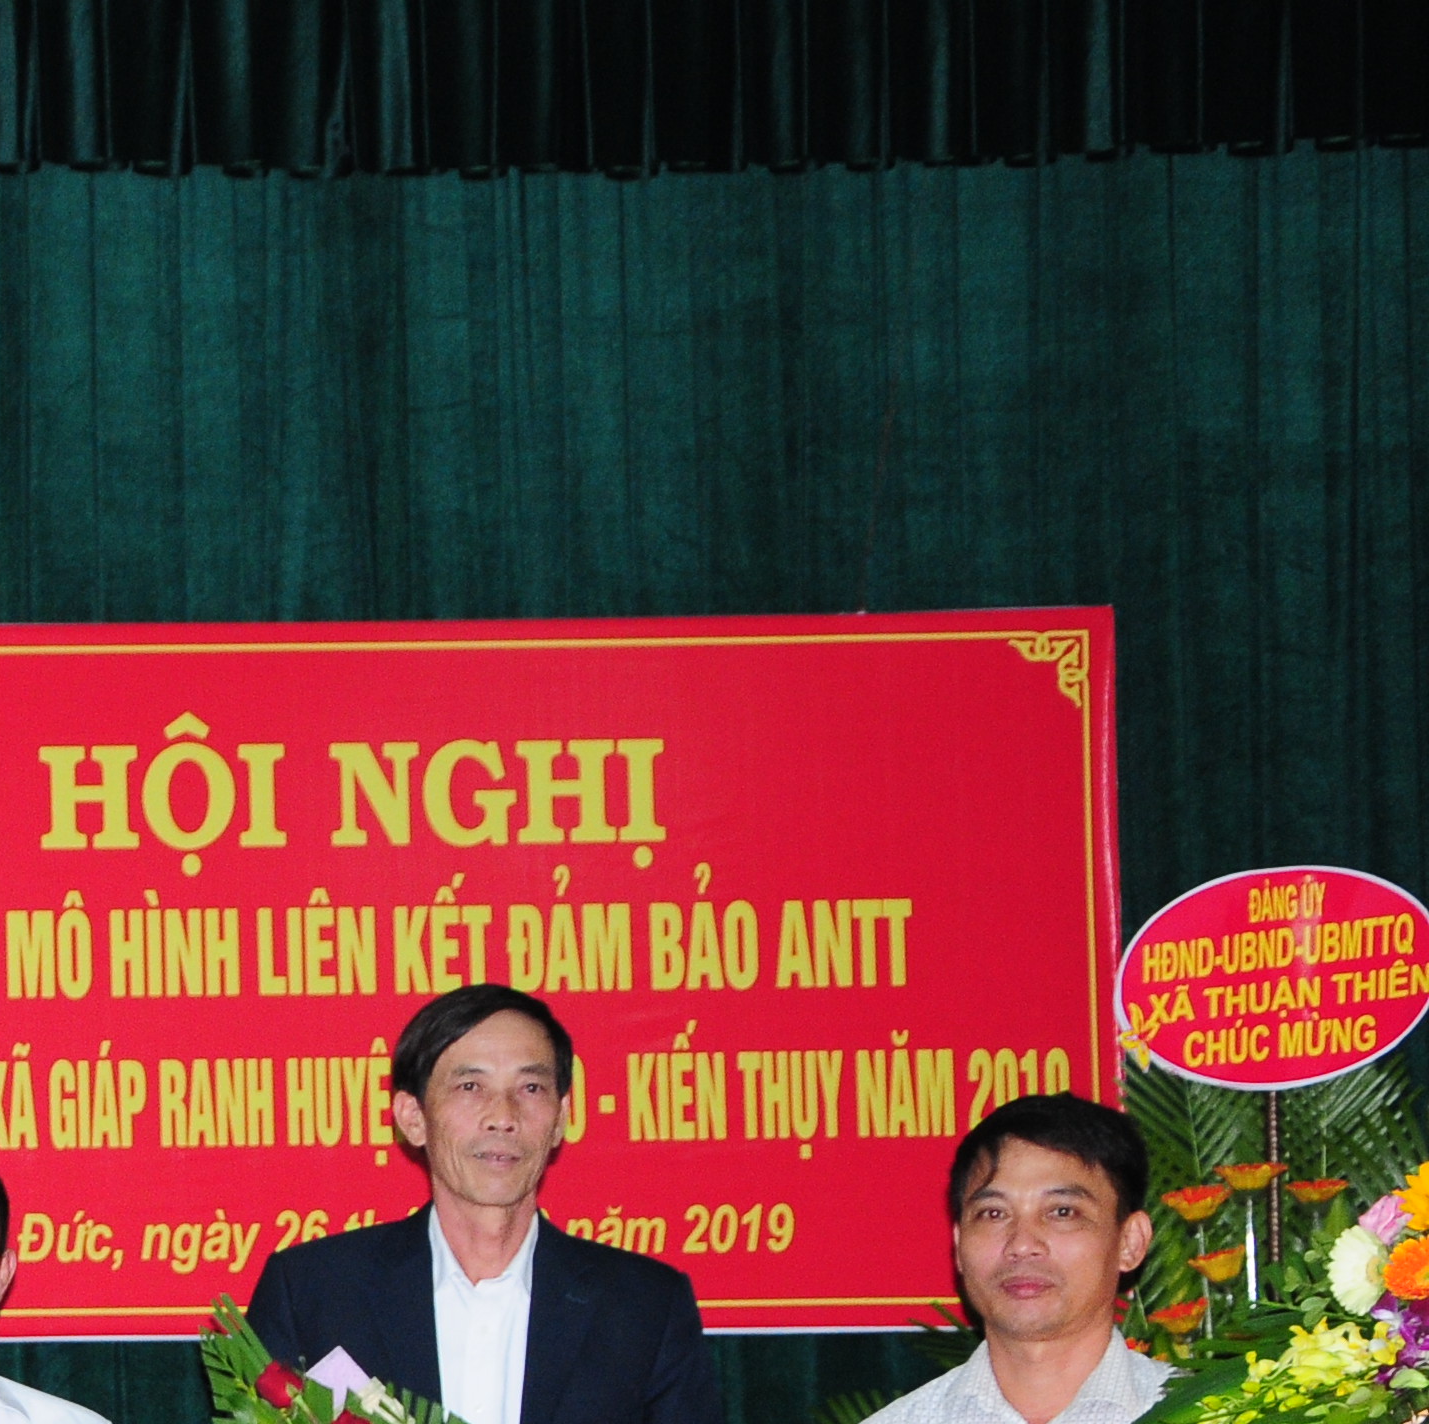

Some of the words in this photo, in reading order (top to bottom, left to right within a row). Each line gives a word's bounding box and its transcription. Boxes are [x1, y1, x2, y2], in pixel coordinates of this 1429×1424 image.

[39, 711, 287, 877] HỘI
[328, 738, 666, 869] NGHỊ
[5, 890, 93, 1000] MÔ
[108, 888, 240, 998] HÌNH
[256, 886, 377, 997] LIÊN
[392, 872, 493, 996] KẾT
[507, 864, 633, 993] ĐẢM
[648, 862, 759, 992] BẢO
[775, 898, 913, 989] ANTT
[1248, 879, 1298, 923] ĐẢNG
[1303, 874, 1325, 919] ỦY
[1142, 913, 1415, 984] HĐND-UBND-UBMTTQ
[1147, 984, 1195, 1024] XÃ
[1203, 975, 1322, 1019] THUẬN
[1332, 959, 1429, 1004] THIÊN
[1183, 1020, 1271, 1068] CHÚC
[1278, 1012, 1377, 1059] MỪNG
[49, 1039, 148, 1150] GIÁP
[159, 1057, 275, 1148] RANH
[285, 1036, 404, 1166] HUYỆ
[598, 1094, 616, 1114] -
[627, 1018, 727, 1141] KIẾN
[737, 1050, 843, 1160] THỤY
[856, 1029, 956, 1138] NĂM
[17, 1209, 124, 1271] Đức,
[141, 1208, 261, 1274] ngày
[274, 1209, 329, 1253] 26
[566, 1205, 667, 1254] năm
[683, 1202, 795, 1253] 2019
